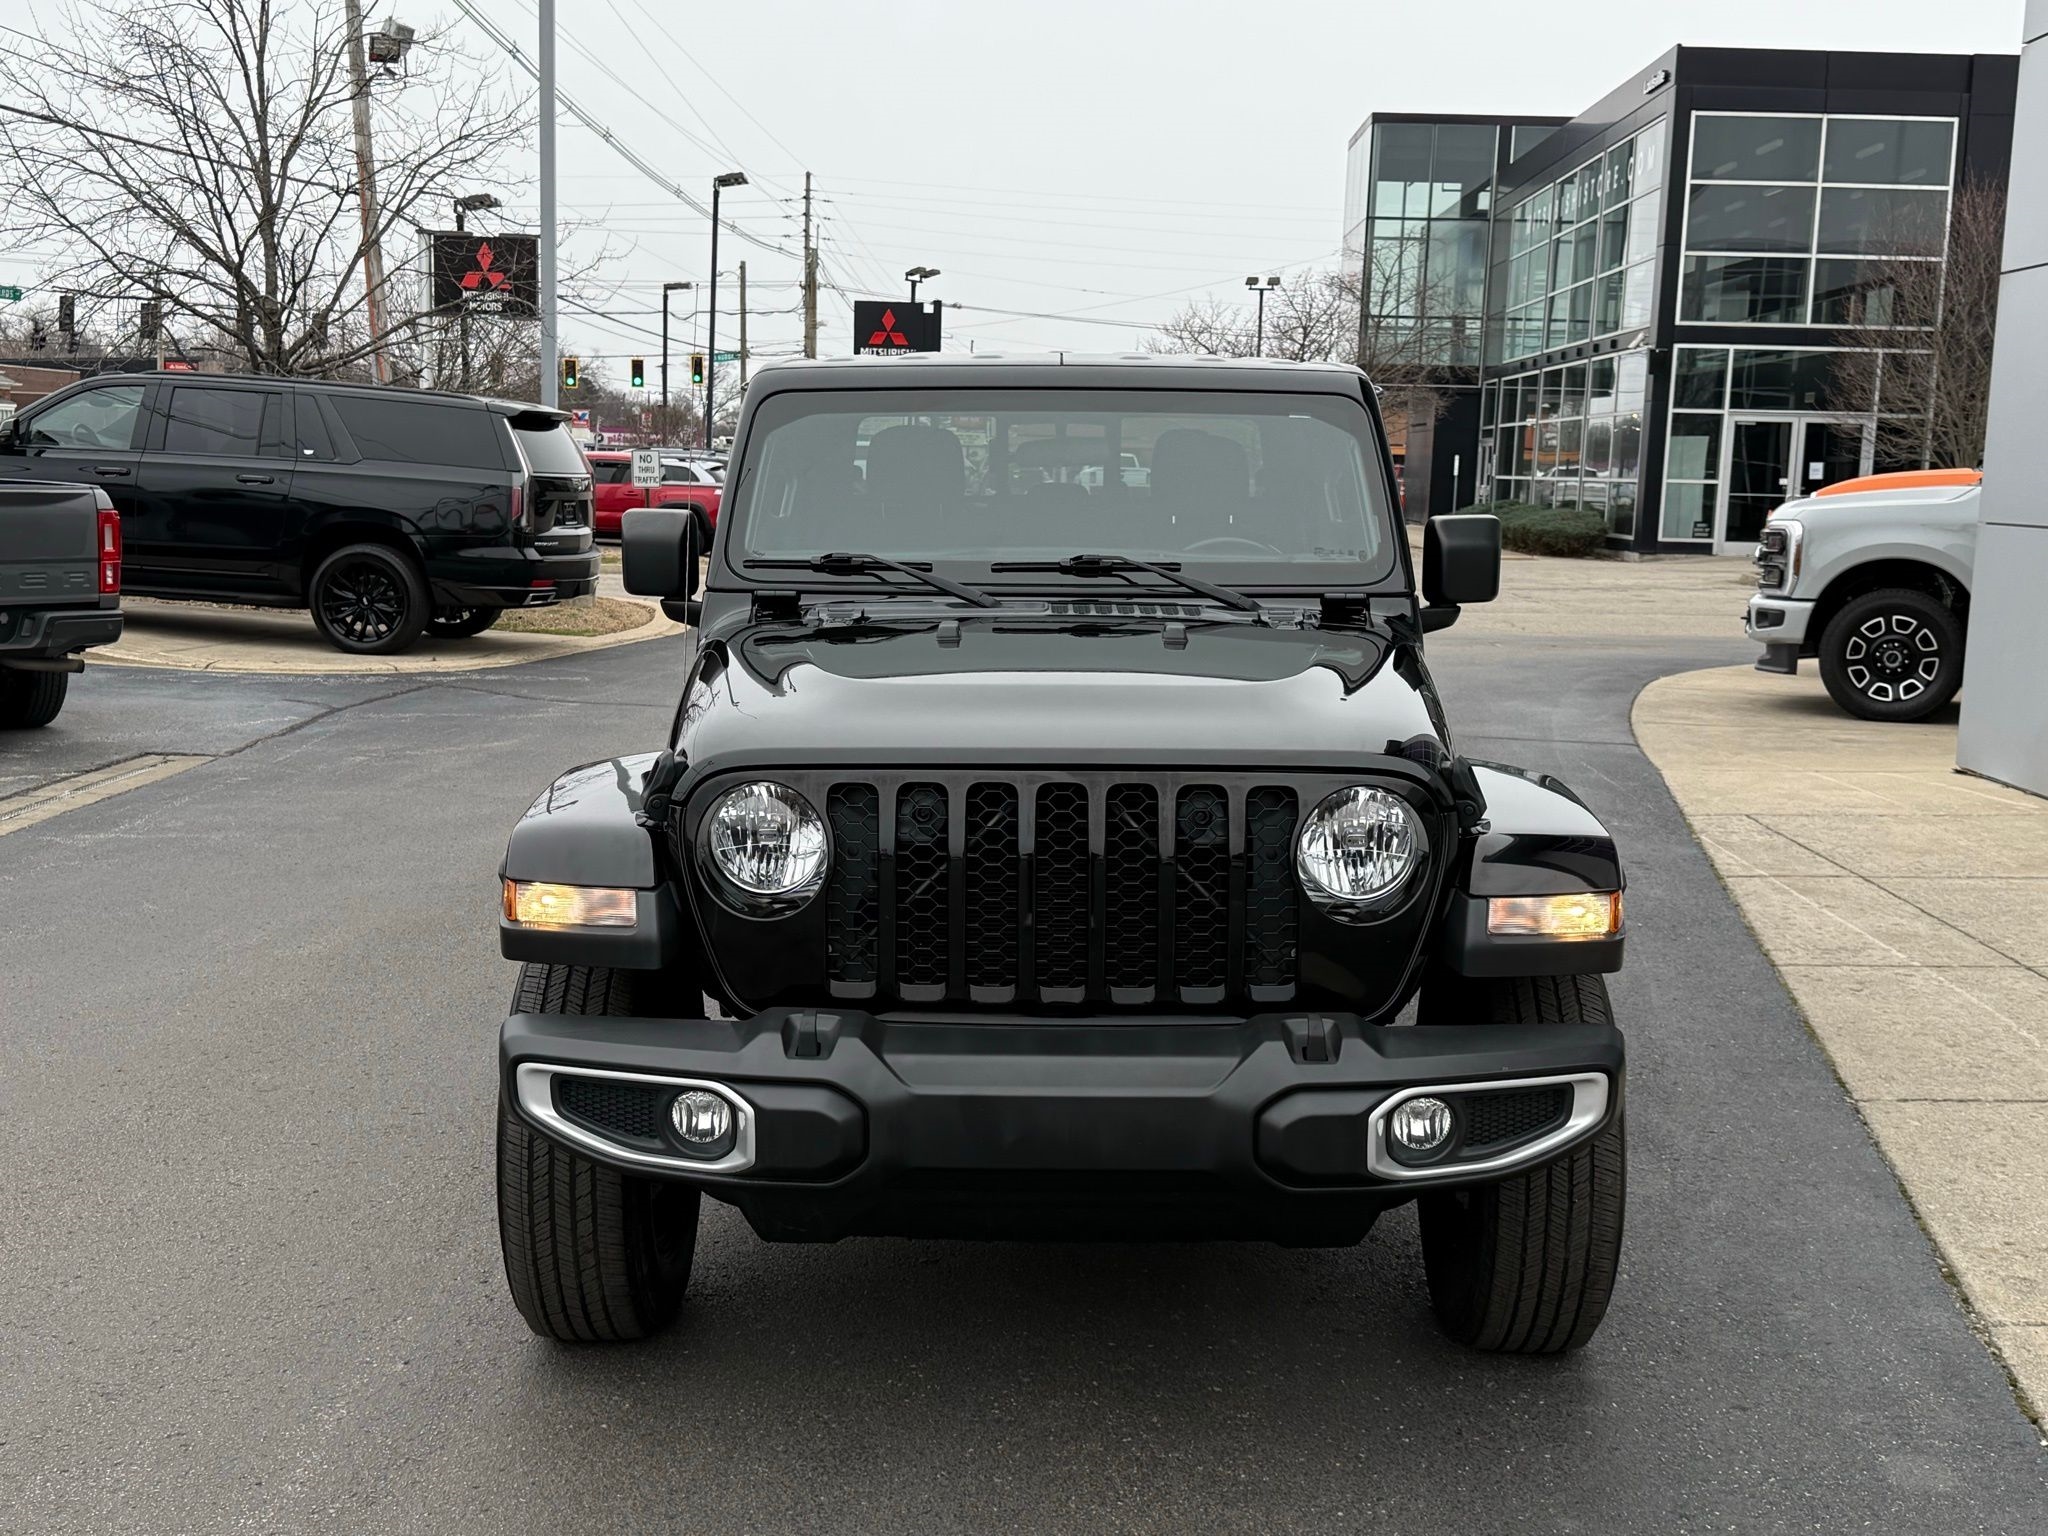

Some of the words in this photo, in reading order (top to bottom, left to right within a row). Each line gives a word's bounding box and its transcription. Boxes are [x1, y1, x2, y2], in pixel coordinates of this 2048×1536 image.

[639, 454, 653, 463] NO
[638, 466, 655, 474] THRU
[634, 476, 659, 484] TRAFFIC
[0, 571, 90, 589] ER
